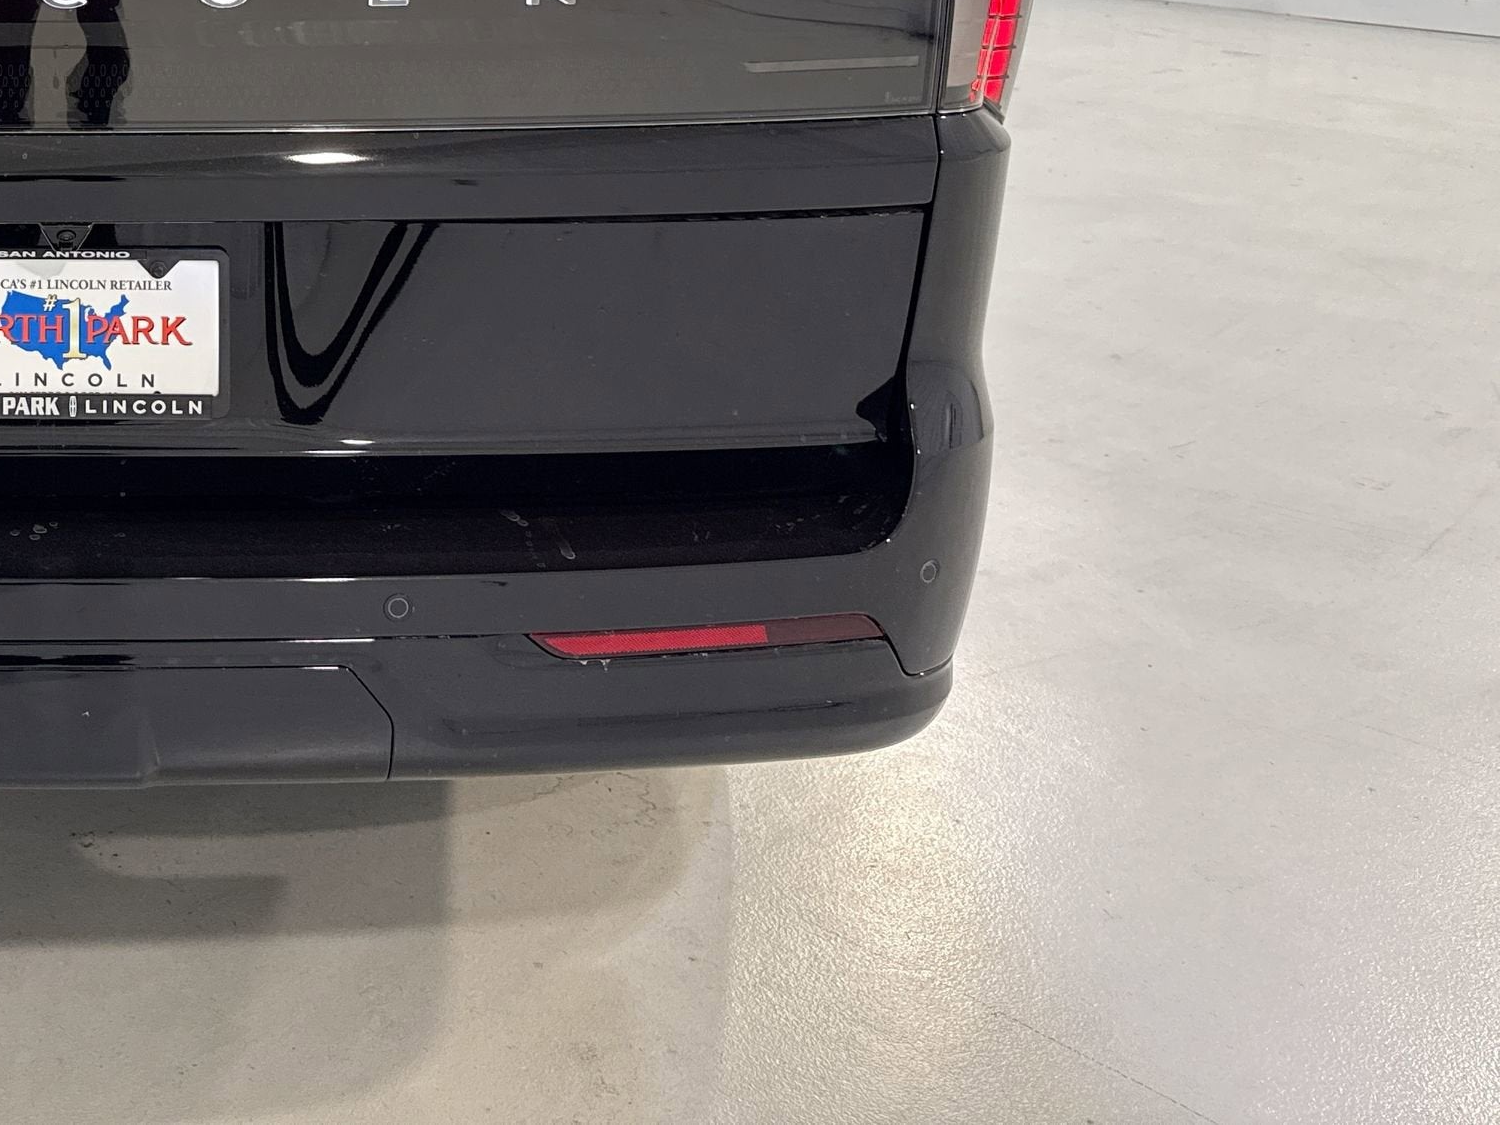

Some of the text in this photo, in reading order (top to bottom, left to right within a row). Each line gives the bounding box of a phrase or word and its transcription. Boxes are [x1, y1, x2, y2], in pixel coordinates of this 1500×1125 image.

[42, 251, 130, 259] ANTONIO
[29, 280, 42, 290] #1
[47, 279, 106, 291] LINCOLN
[110, 280, 172, 291] RETAILER
[86, 315, 193, 346] PARK
[2, 396, 60, 416] PARK
[85, 399, 203, 415] LINCOLN
